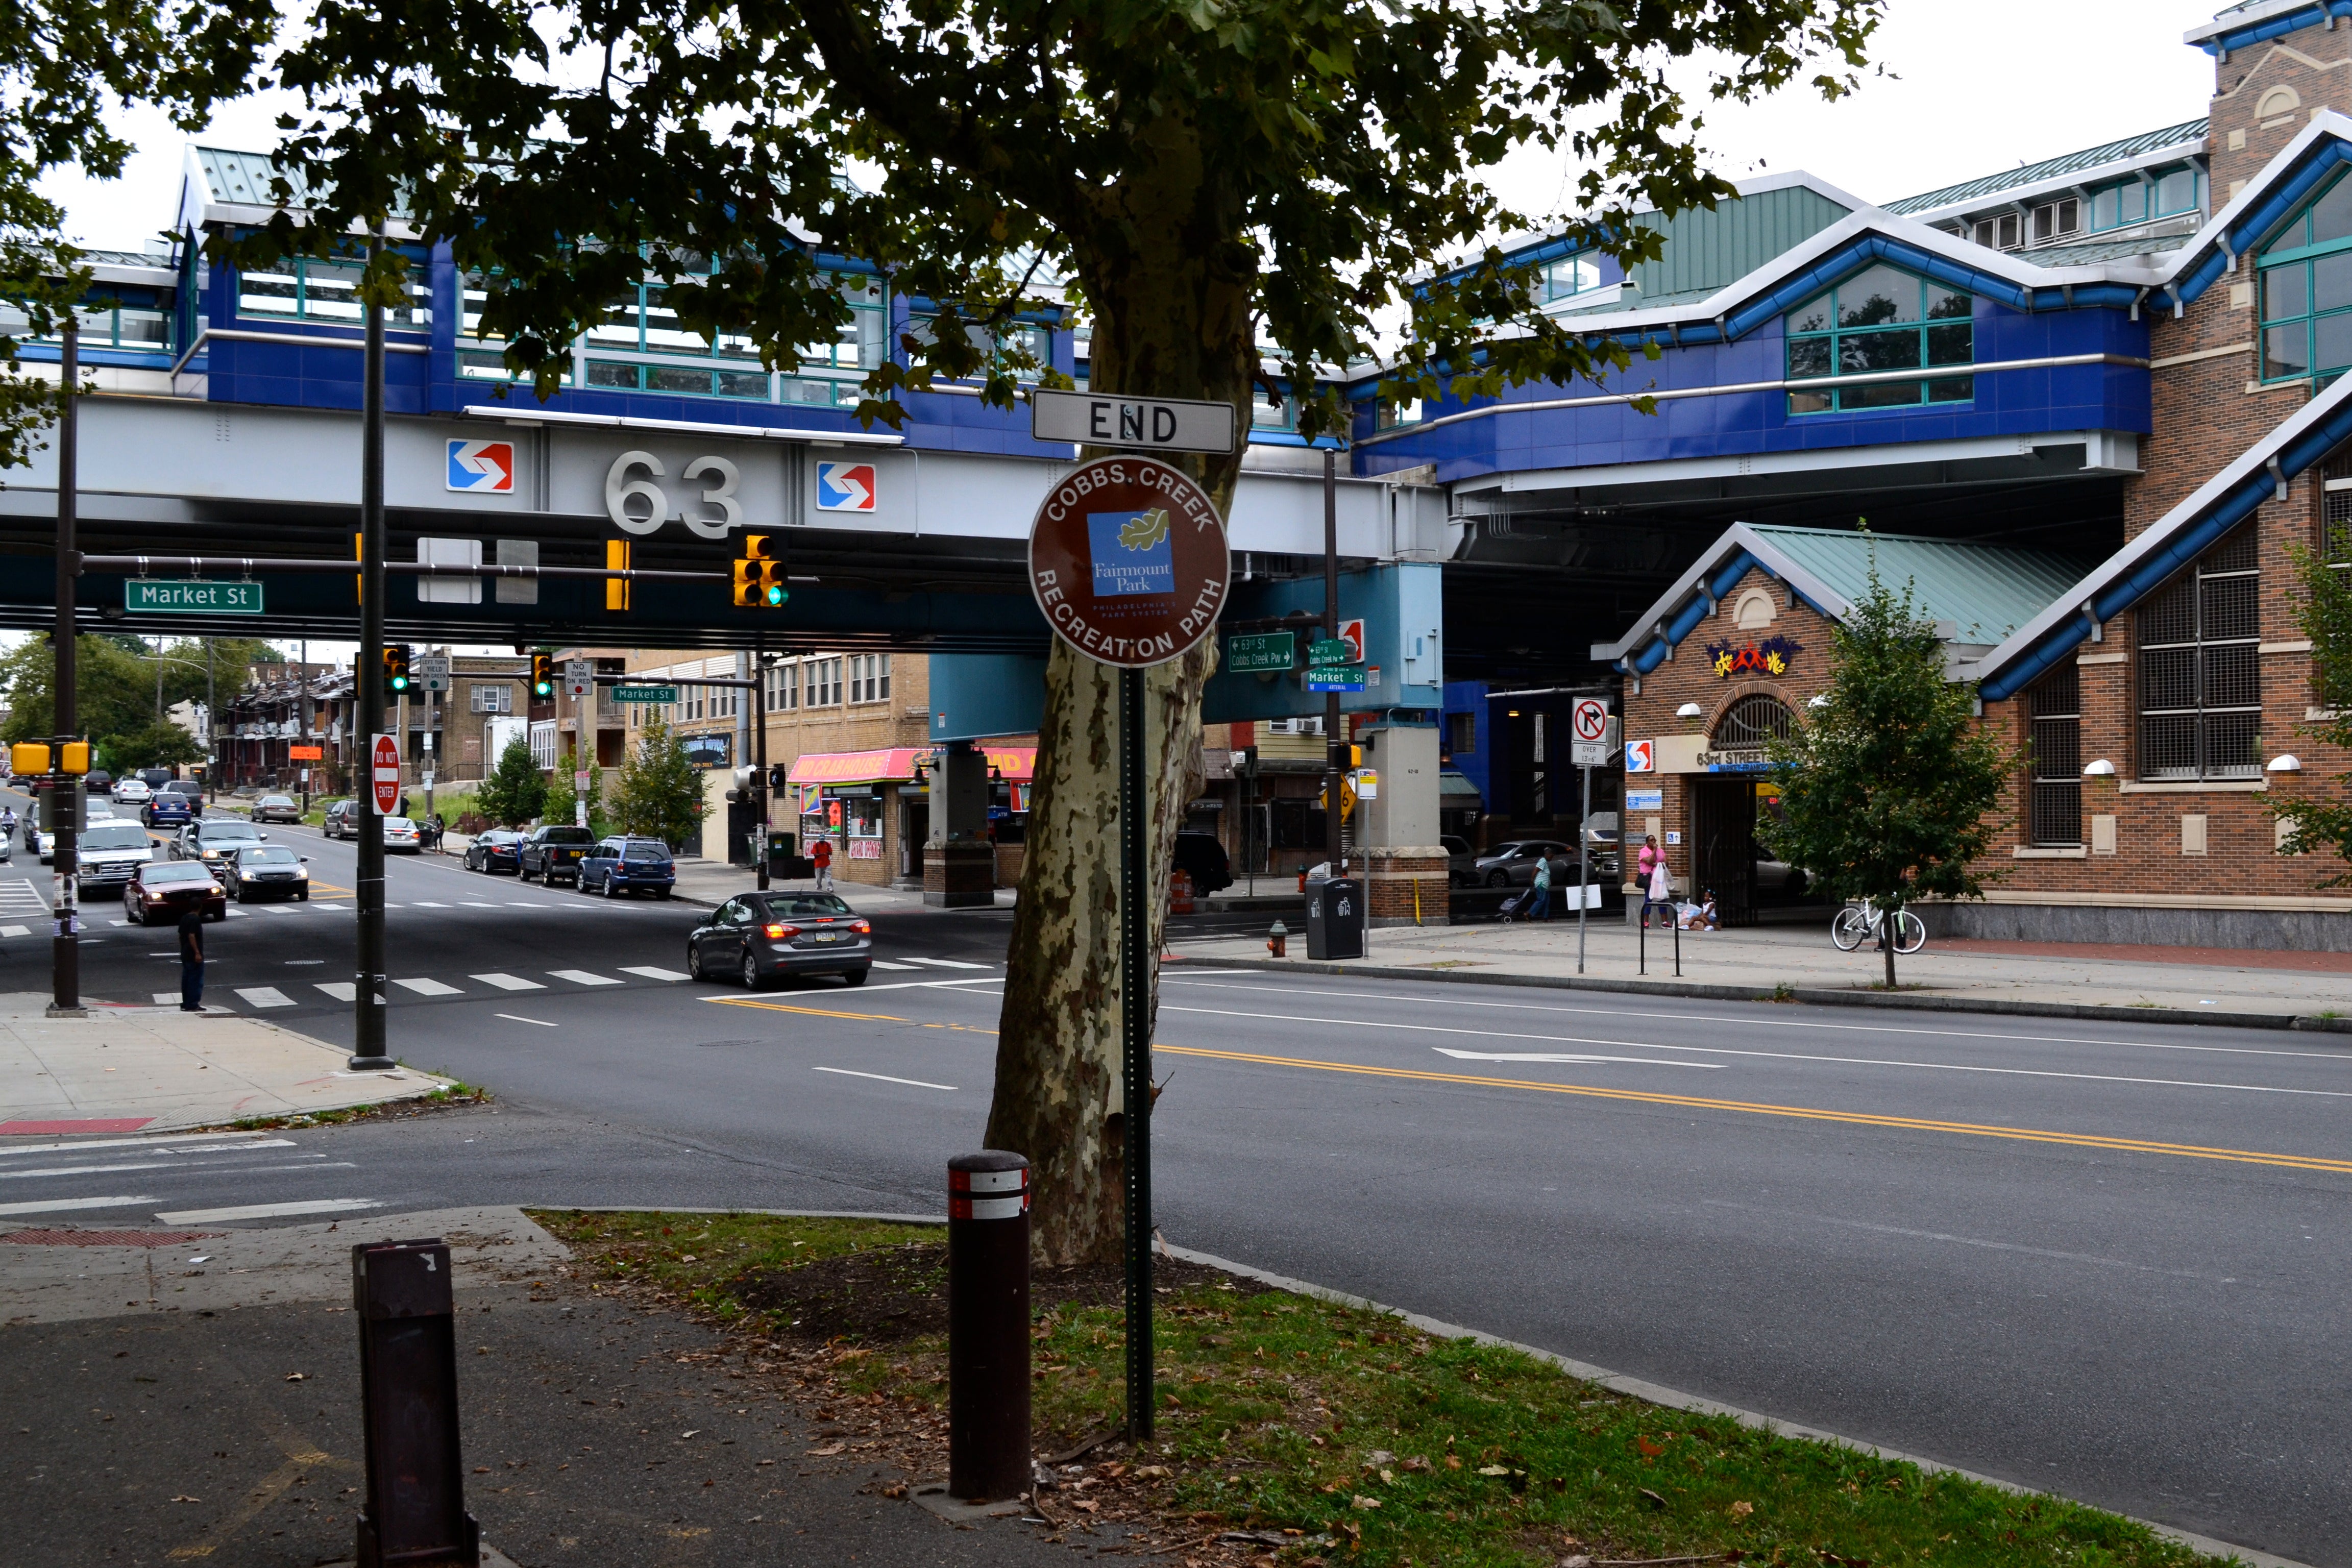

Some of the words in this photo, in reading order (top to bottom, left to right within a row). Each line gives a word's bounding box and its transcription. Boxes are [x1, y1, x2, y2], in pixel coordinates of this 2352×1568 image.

[1090, 401, 1177, 443] END
[605, 450, 743, 539] 63
[1047, 464, 1125, 522] COBBS
[1139, 467, 1214, 532] CREEK
[1095, 562, 1171, 578] Fairmount
[1116, 577, 1150, 592] Park
[142, 586, 216, 604] Market
[227, 588, 247, 604] St
[1093, 601, 1176, 610] PHILADELPHIA'S
[1037, 569, 1174, 658] RECREATION
[1179, 578, 1222, 637] PATH
[1241, 638, 1255, 650] 63rd
[1258, 638, 1265, 649] St
[1232, 654, 1250, 666] Cobbs
[1252, 652, 1268, 665] Creek
[1321, 655, 1332, 663] Creek
[1309, 672, 1343, 682] Market
[1354, 674, 1363, 682] St
[619, 690, 654, 699] Market
[659, 691, 669, 699] St
[376, 751, 383, 763] DO
[386, 752, 396, 764] NOT
[984, 754, 1020, 771] MD
[1697, 752, 1721, 766] 63rd
[1726, 751, 1767, 765] STREET
[796, 761, 815, 776] MD
[379, 786, 394, 798] ENTER
